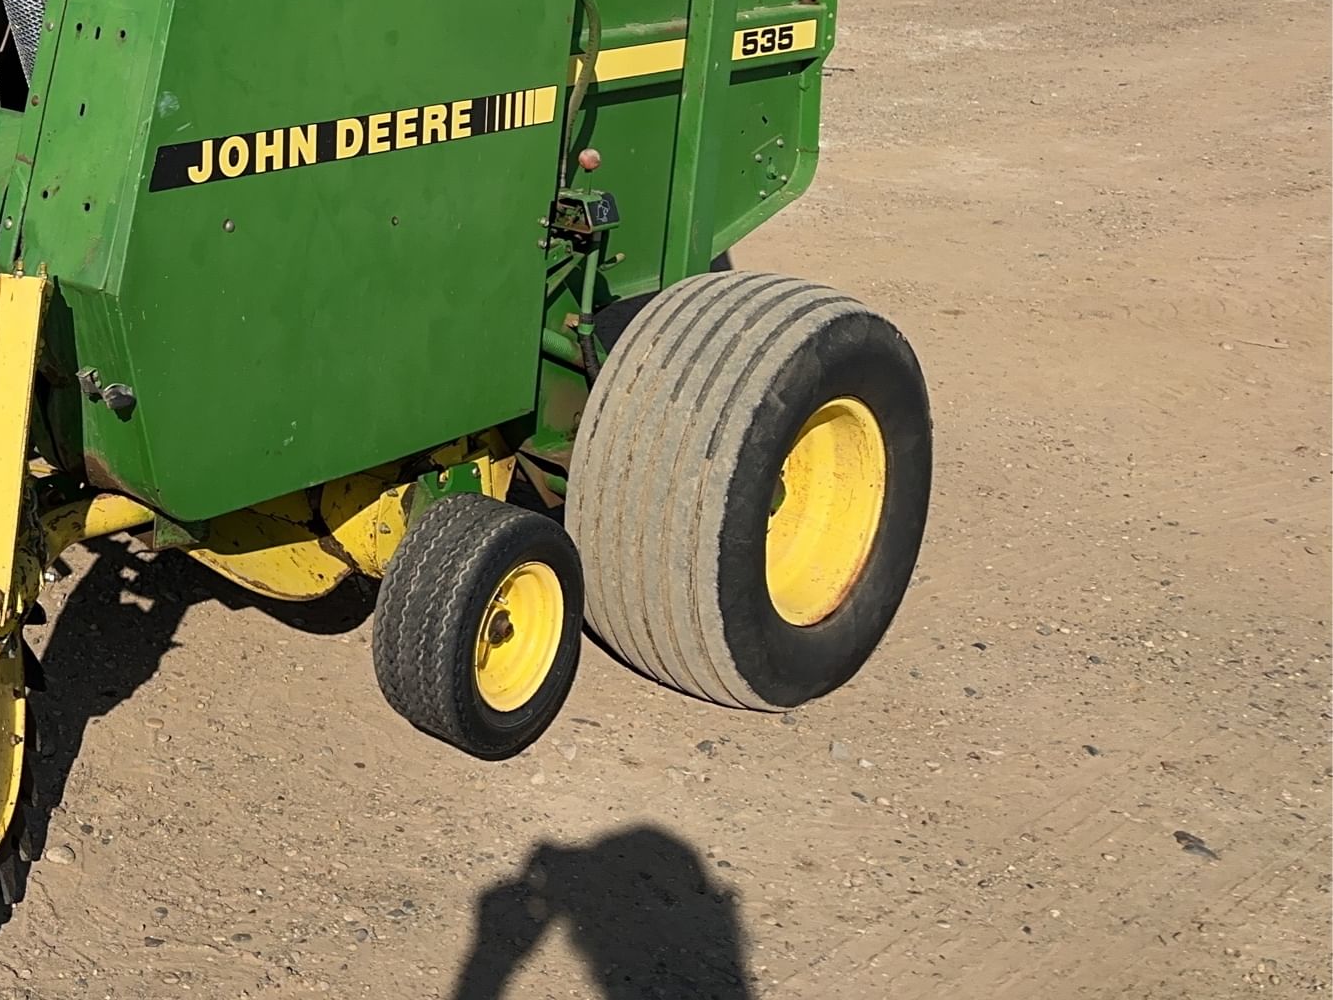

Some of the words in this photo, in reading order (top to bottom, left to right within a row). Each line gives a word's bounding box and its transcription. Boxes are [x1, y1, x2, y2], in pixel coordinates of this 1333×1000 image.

[742, 25, 794, 56] 535
[187, 124, 317, 184] JOHN
[335, 99, 473, 160] DEERE
